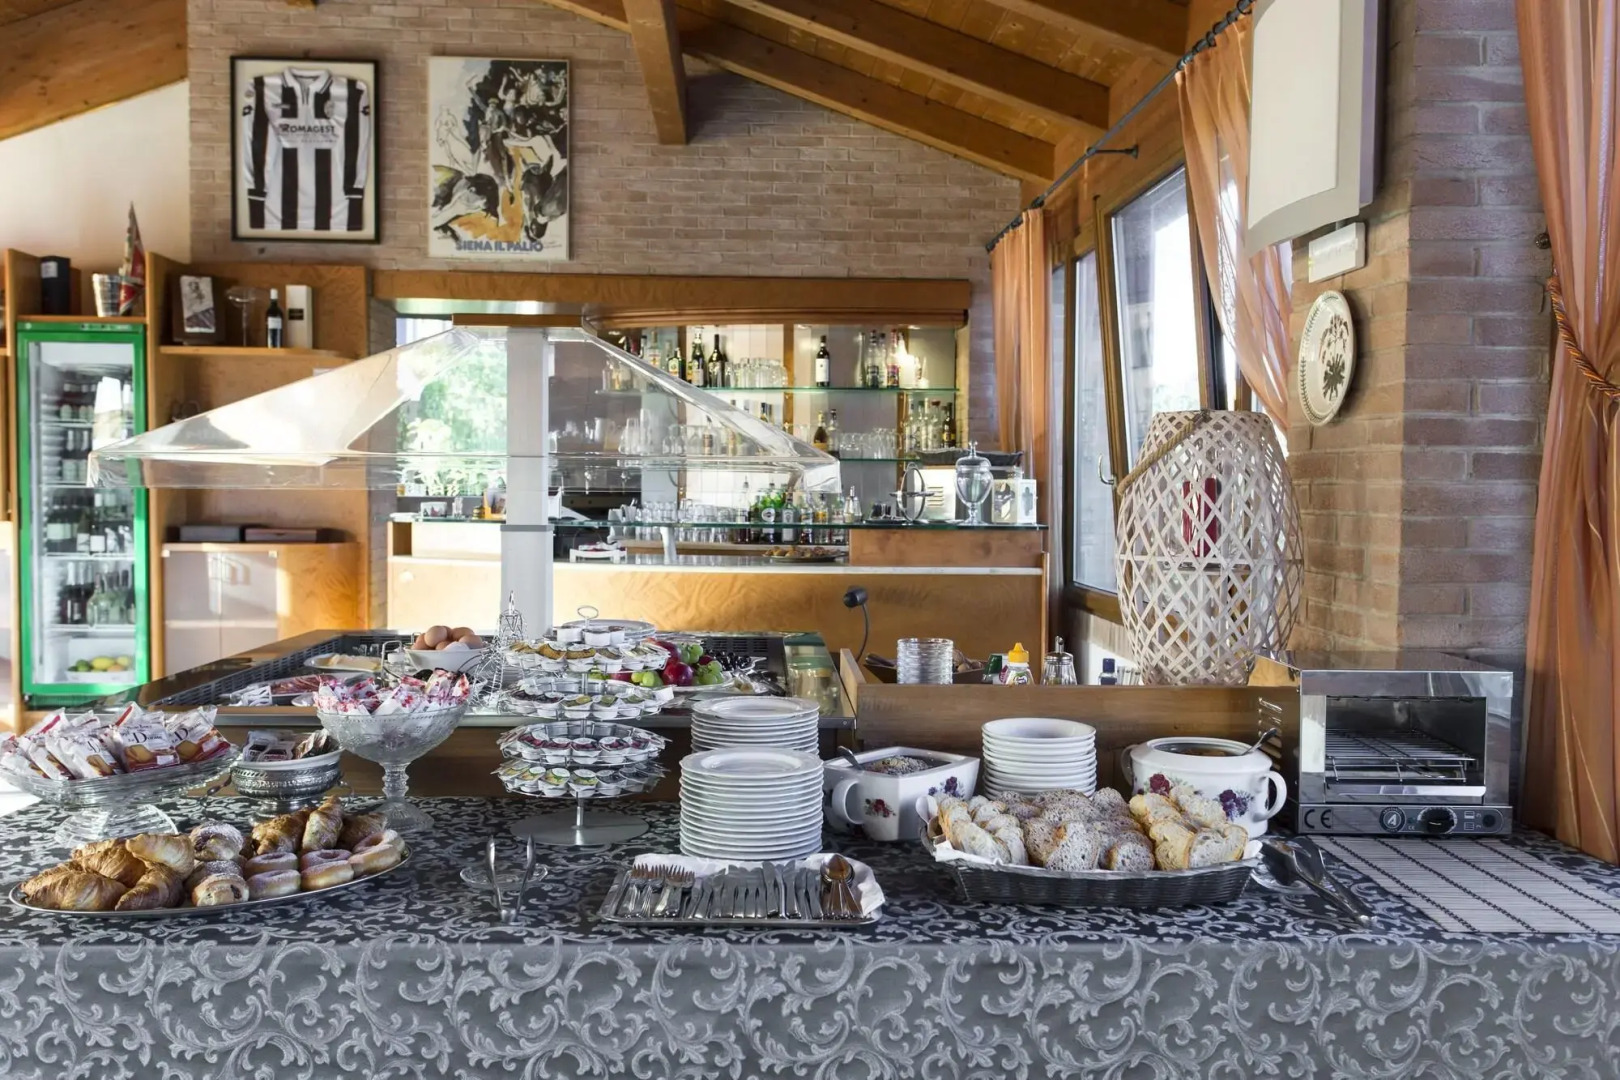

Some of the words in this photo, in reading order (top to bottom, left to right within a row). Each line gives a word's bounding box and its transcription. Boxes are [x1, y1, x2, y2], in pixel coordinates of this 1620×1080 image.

[279, 124, 335, 134] ROMAGEST
[456, 240, 492, 251] SIENA
[495, 240, 505, 251] IL
[507, 241, 544, 252] PALIO
[1304, 809, 1331, 829] CE
